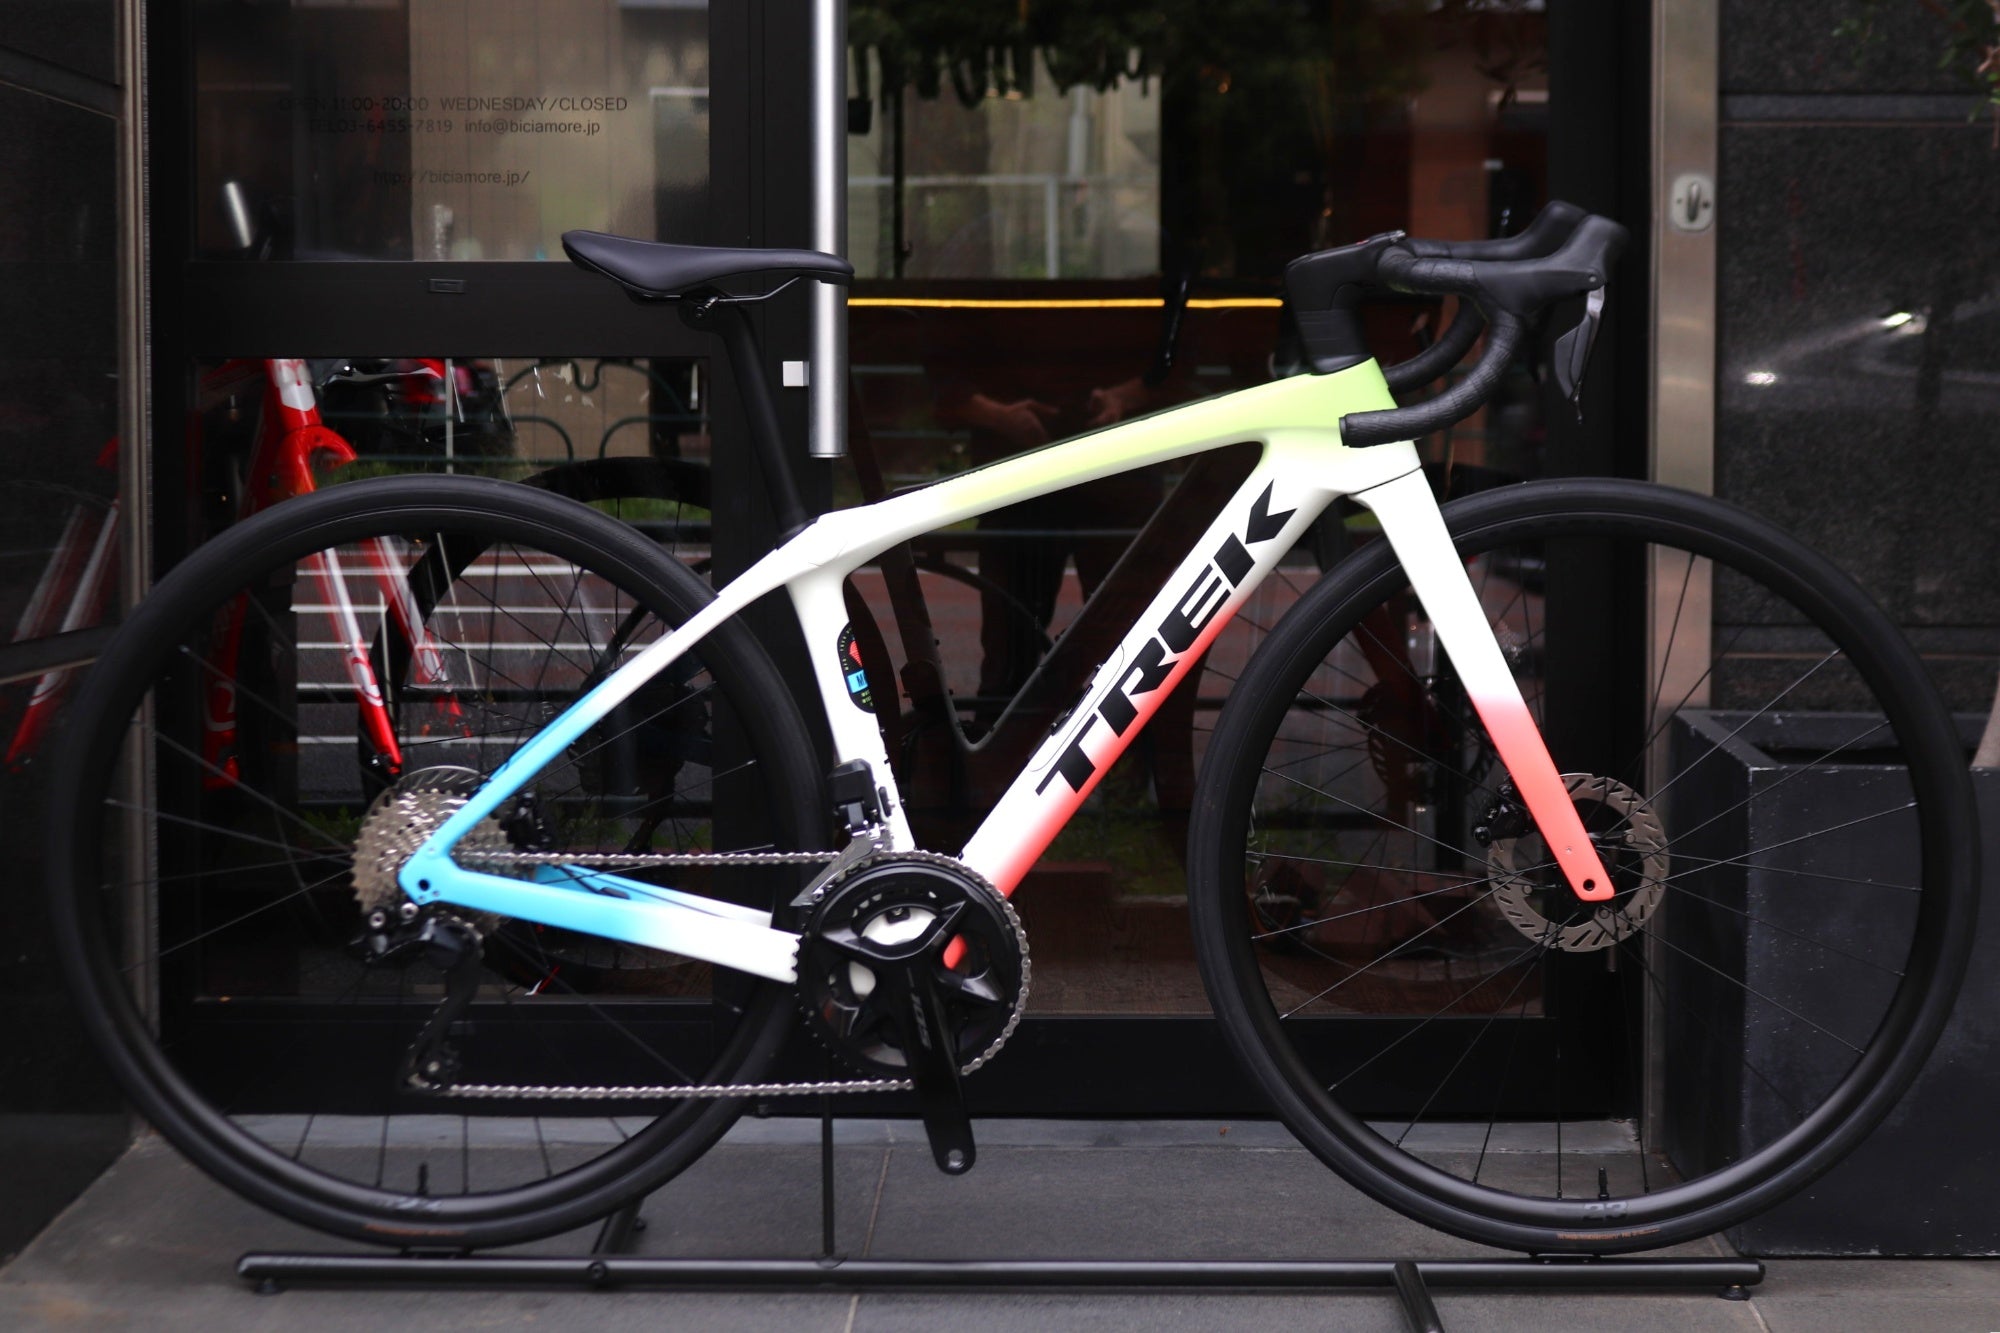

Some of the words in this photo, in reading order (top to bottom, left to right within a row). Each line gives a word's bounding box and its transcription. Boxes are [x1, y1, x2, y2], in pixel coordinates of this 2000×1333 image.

[440, 97, 628, 112] WEDNESDAY/CLOSED
[465, 119, 600, 136] info@biciamore.jp
[373, 170, 530, 186] http://biciamore.jp/
[1035, 478, 1298, 796] TREK
